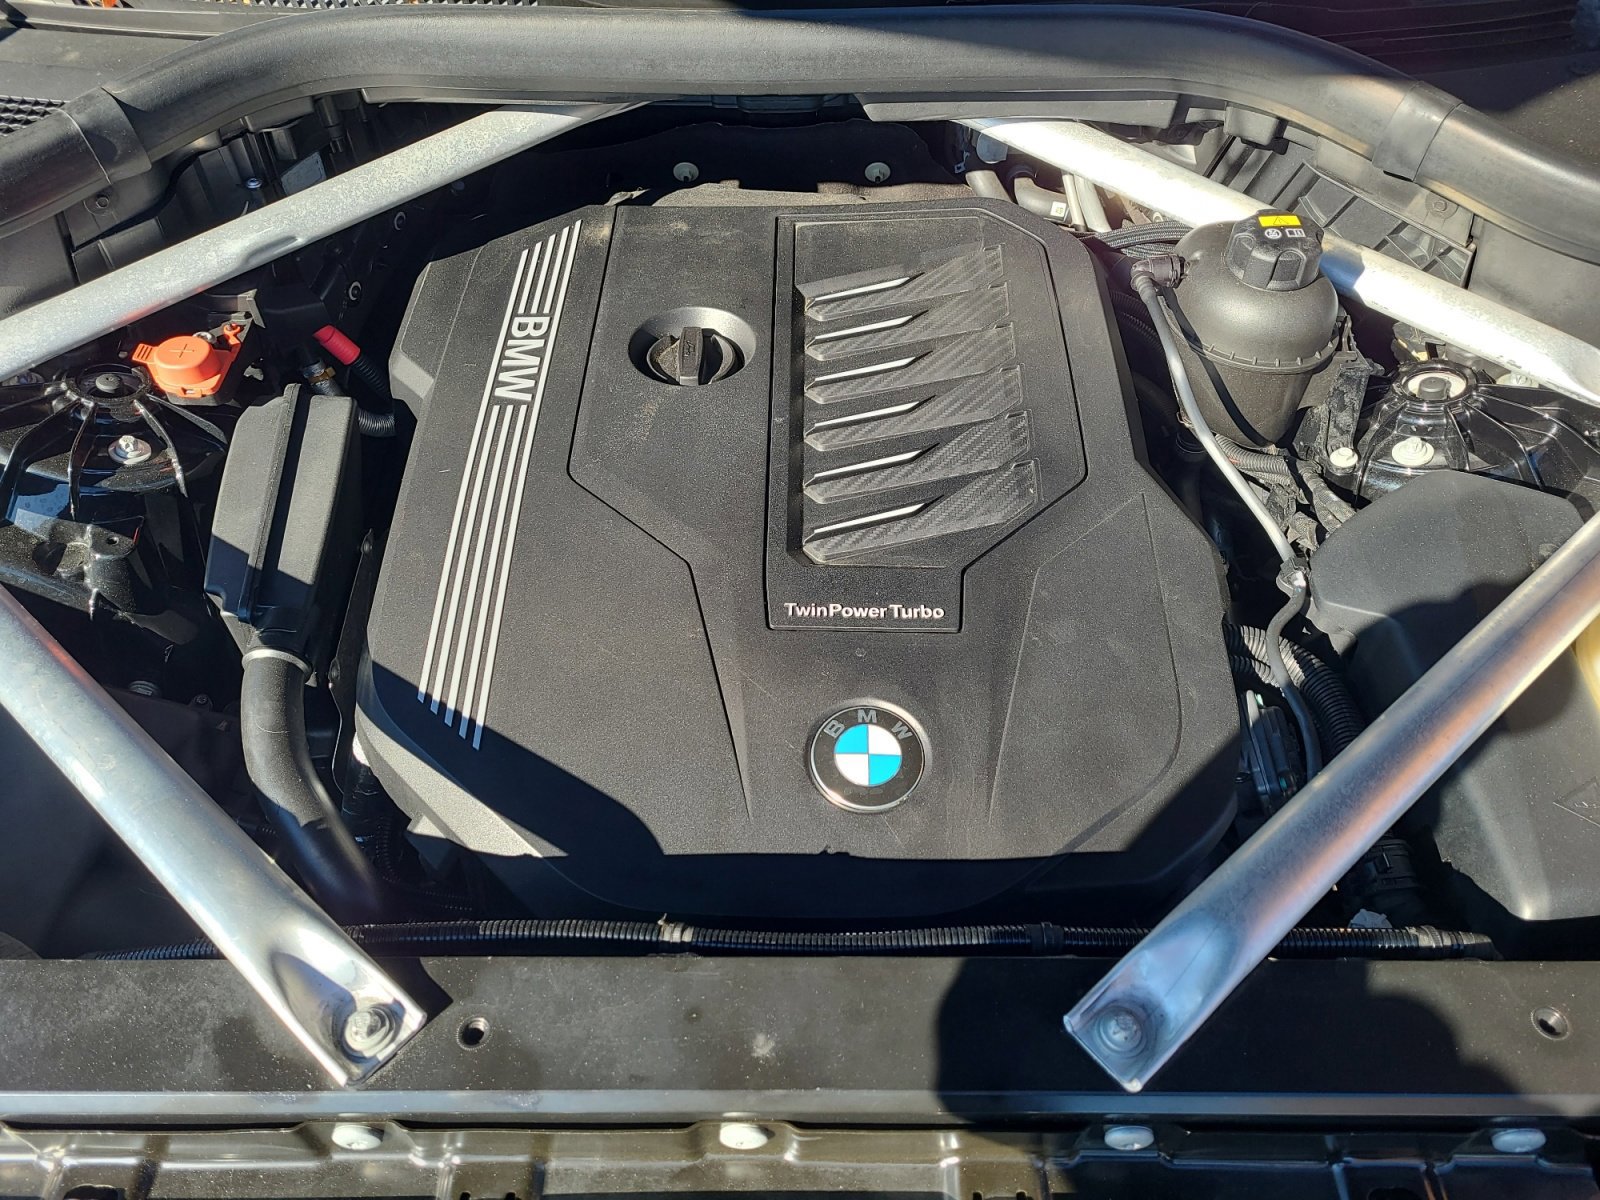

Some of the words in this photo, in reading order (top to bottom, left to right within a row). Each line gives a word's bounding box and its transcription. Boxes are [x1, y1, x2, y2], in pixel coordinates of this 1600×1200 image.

[494, 316, 550, 401] BMW
[889, 604, 944, 619] Turbo
[823, 709, 913, 740] BMW
